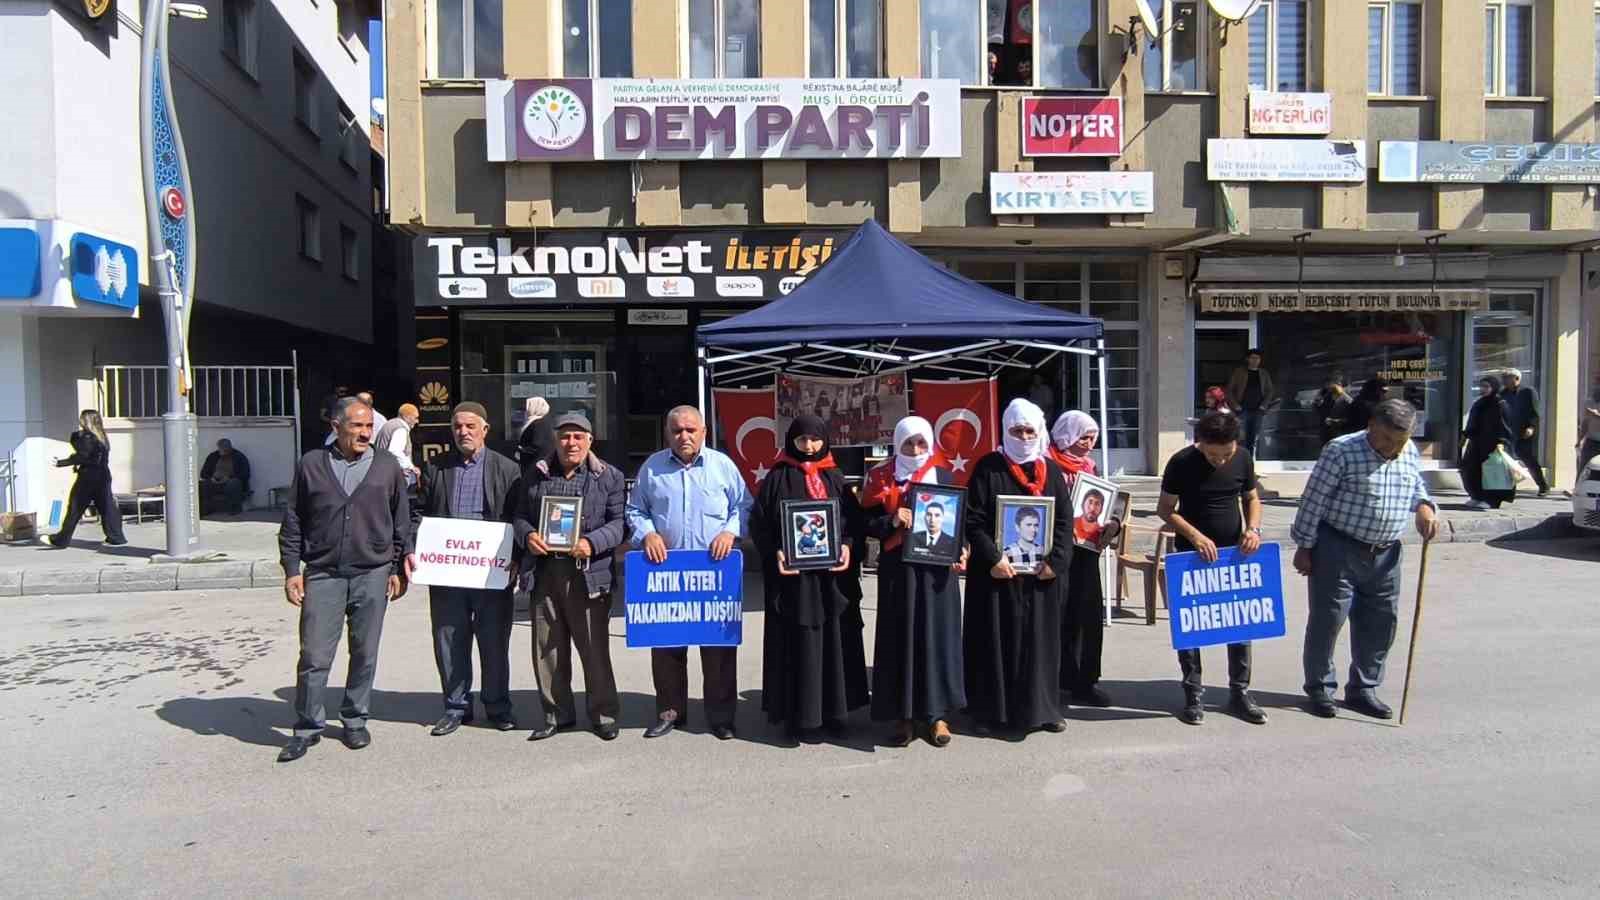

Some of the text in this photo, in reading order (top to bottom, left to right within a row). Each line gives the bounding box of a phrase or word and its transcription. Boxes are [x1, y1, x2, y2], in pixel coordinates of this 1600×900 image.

[803, 95, 830, 105] MUŞ
[614, 91, 930, 151] DEM PARTİ
[1030, 114, 1115, 138] NOTER
[427, 237, 836, 276] TeknoNet İLETİŞİ
[1396, 295, 1441, 308] BULUNUR
[445, 539, 482, 551] EVLAT
[646, 569, 723, 593] ARTIK YETER !
[1181, 562, 1263, 597] ANNELER
[626, 595, 742, 630] YAKAMIZDAN DÜŞÜN
[1179, 594, 1276, 633] DİRENİYOR
